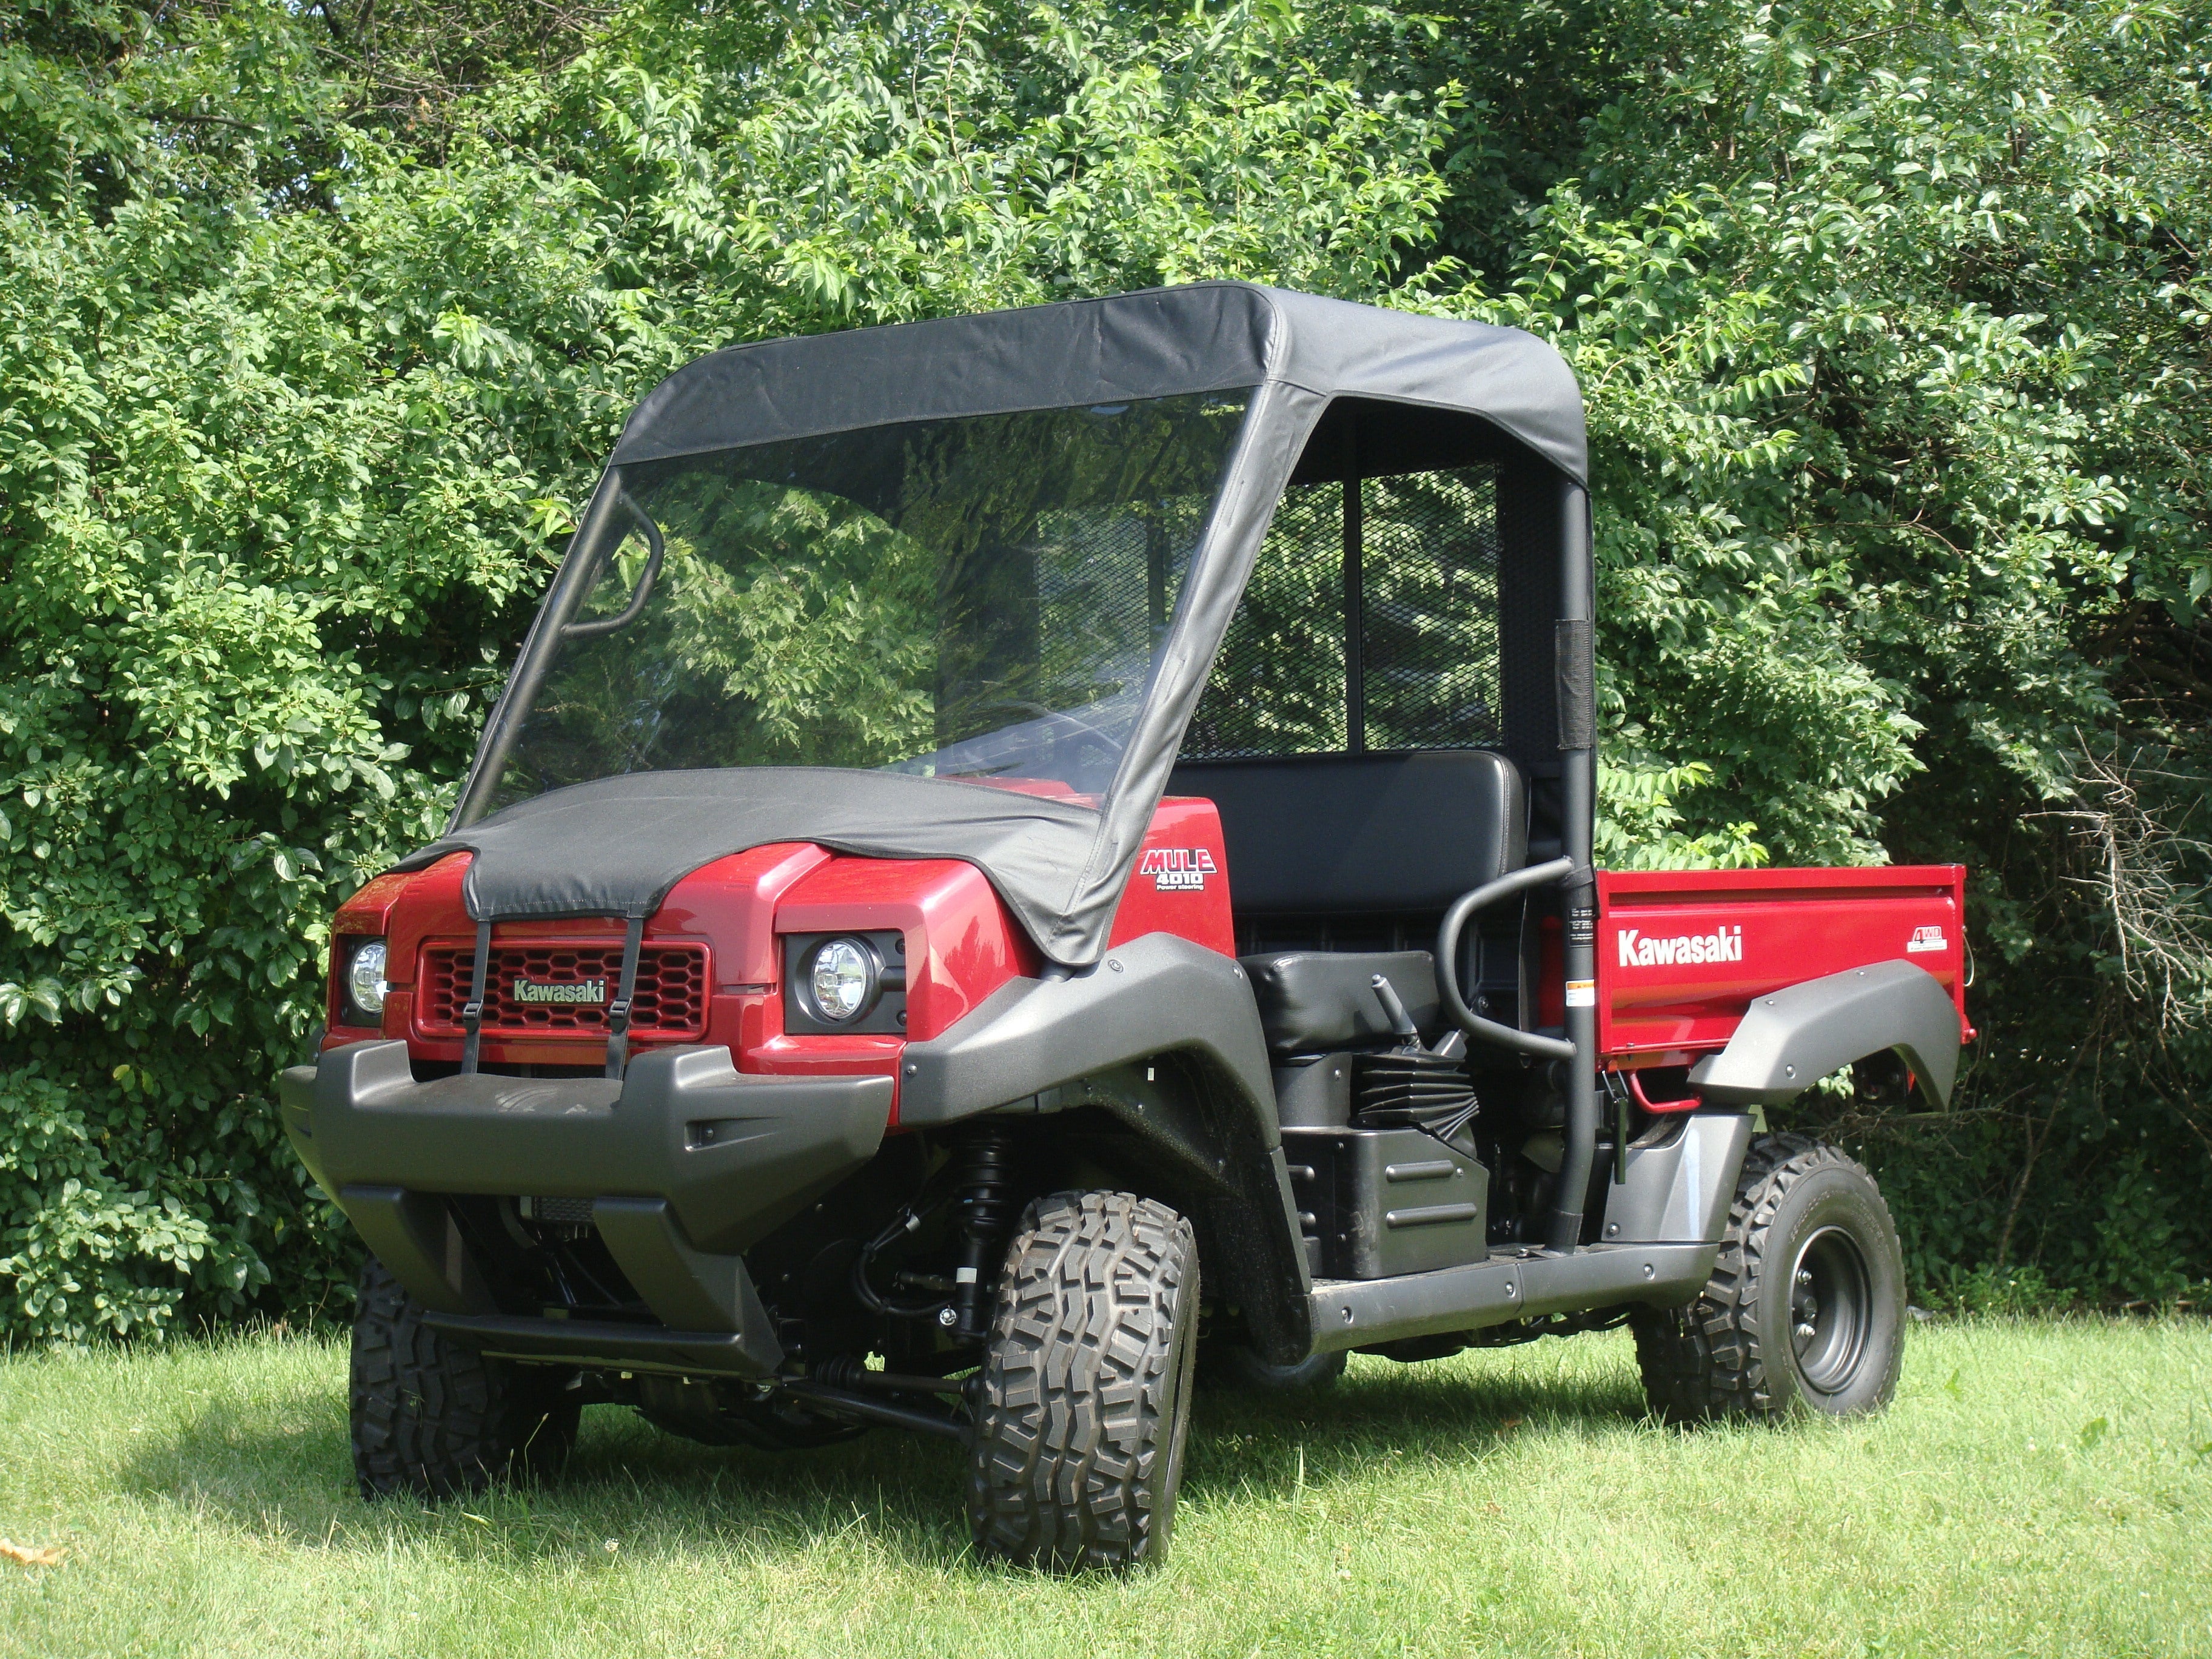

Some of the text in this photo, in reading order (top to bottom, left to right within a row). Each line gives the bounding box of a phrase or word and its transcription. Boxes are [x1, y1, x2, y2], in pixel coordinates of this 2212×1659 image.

[1141, 849, 1218, 874] MULE
[1156, 873, 1204, 885] 4010
[1618, 925, 1742, 967] Kawasaki
[514, 979, 605, 1002] Kawasaki
